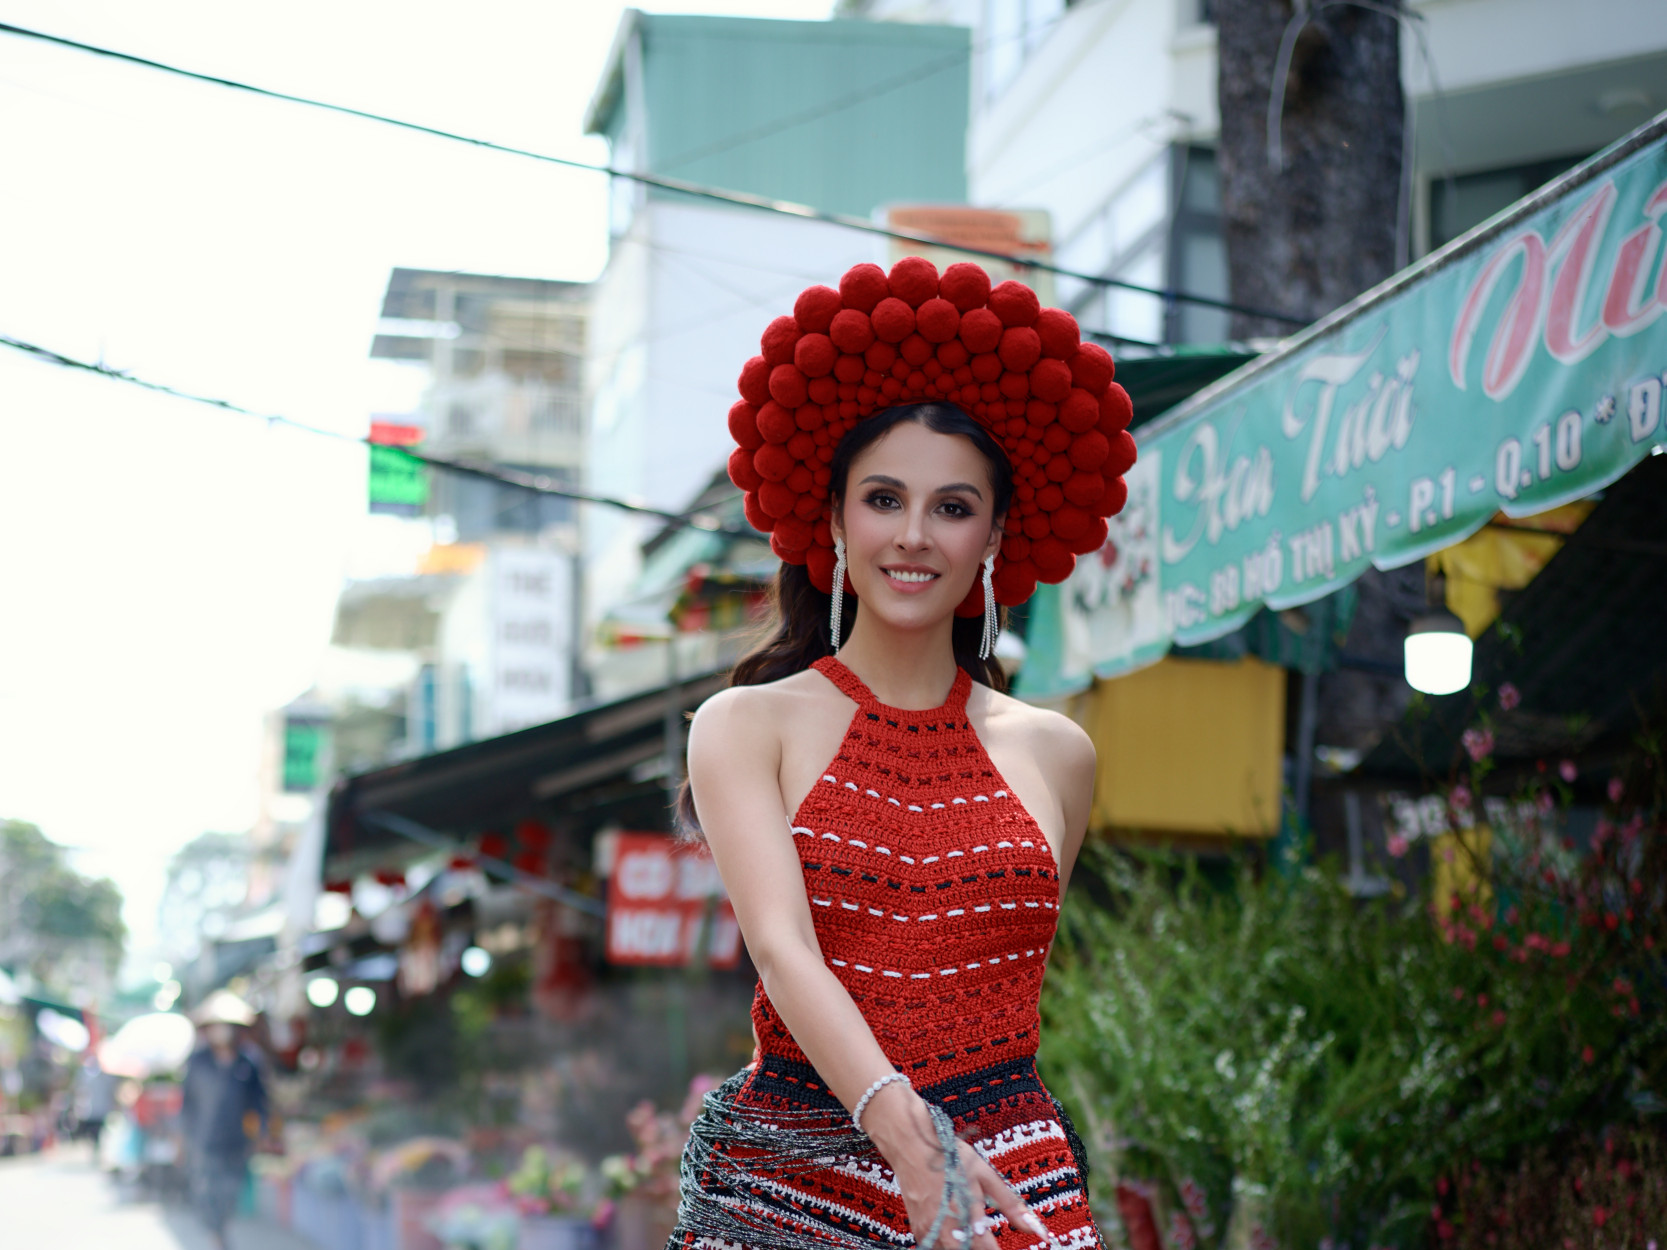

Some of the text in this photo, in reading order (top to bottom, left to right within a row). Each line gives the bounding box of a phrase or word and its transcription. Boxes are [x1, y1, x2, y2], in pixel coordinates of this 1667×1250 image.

[1290, 518, 1335, 581] THỊ
[1409, 464, 1456, 535] P.1
[1495, 409, 1584, 500] Q.10
